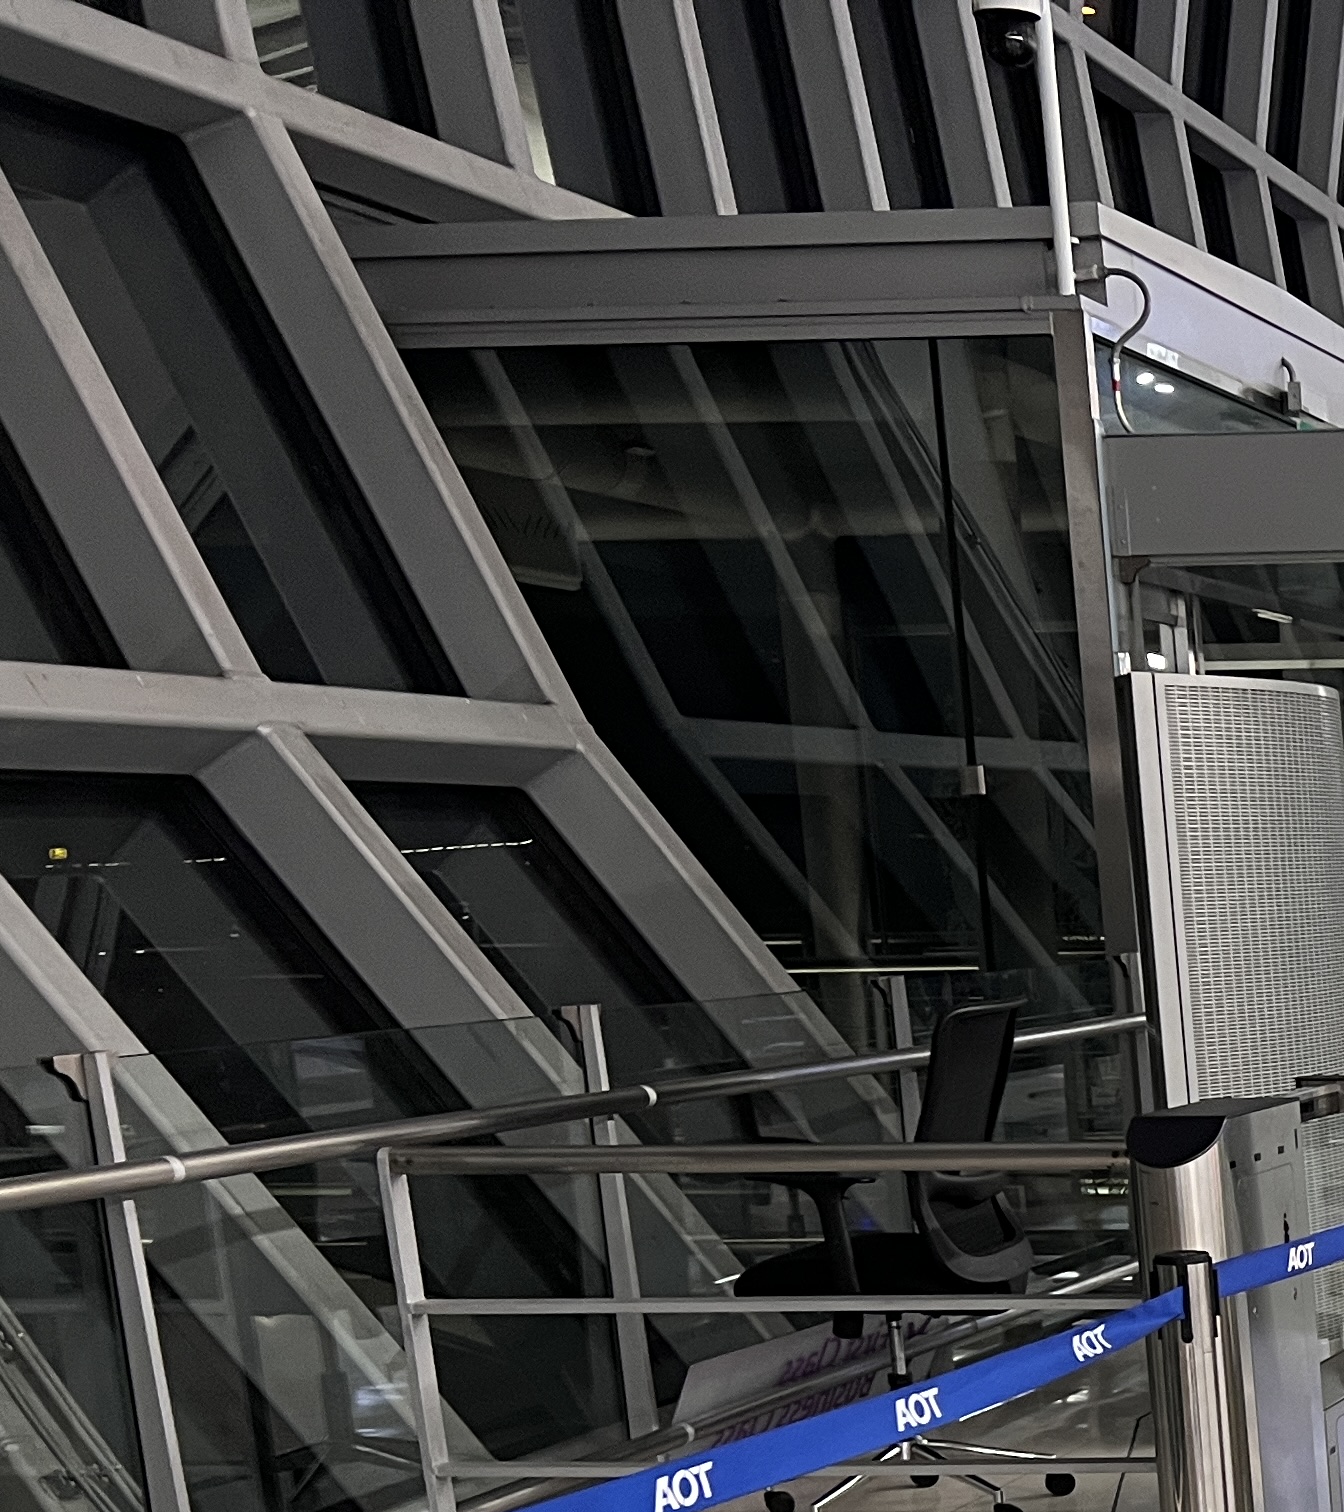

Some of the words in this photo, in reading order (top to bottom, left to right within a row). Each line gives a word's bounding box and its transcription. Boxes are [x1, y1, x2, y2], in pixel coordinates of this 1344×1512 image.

[1287, 1241, 1315, 1272] AOT
[1072, 1323, 1112, 1362] AOT
[895, 1387, 942, 1432] AOT
